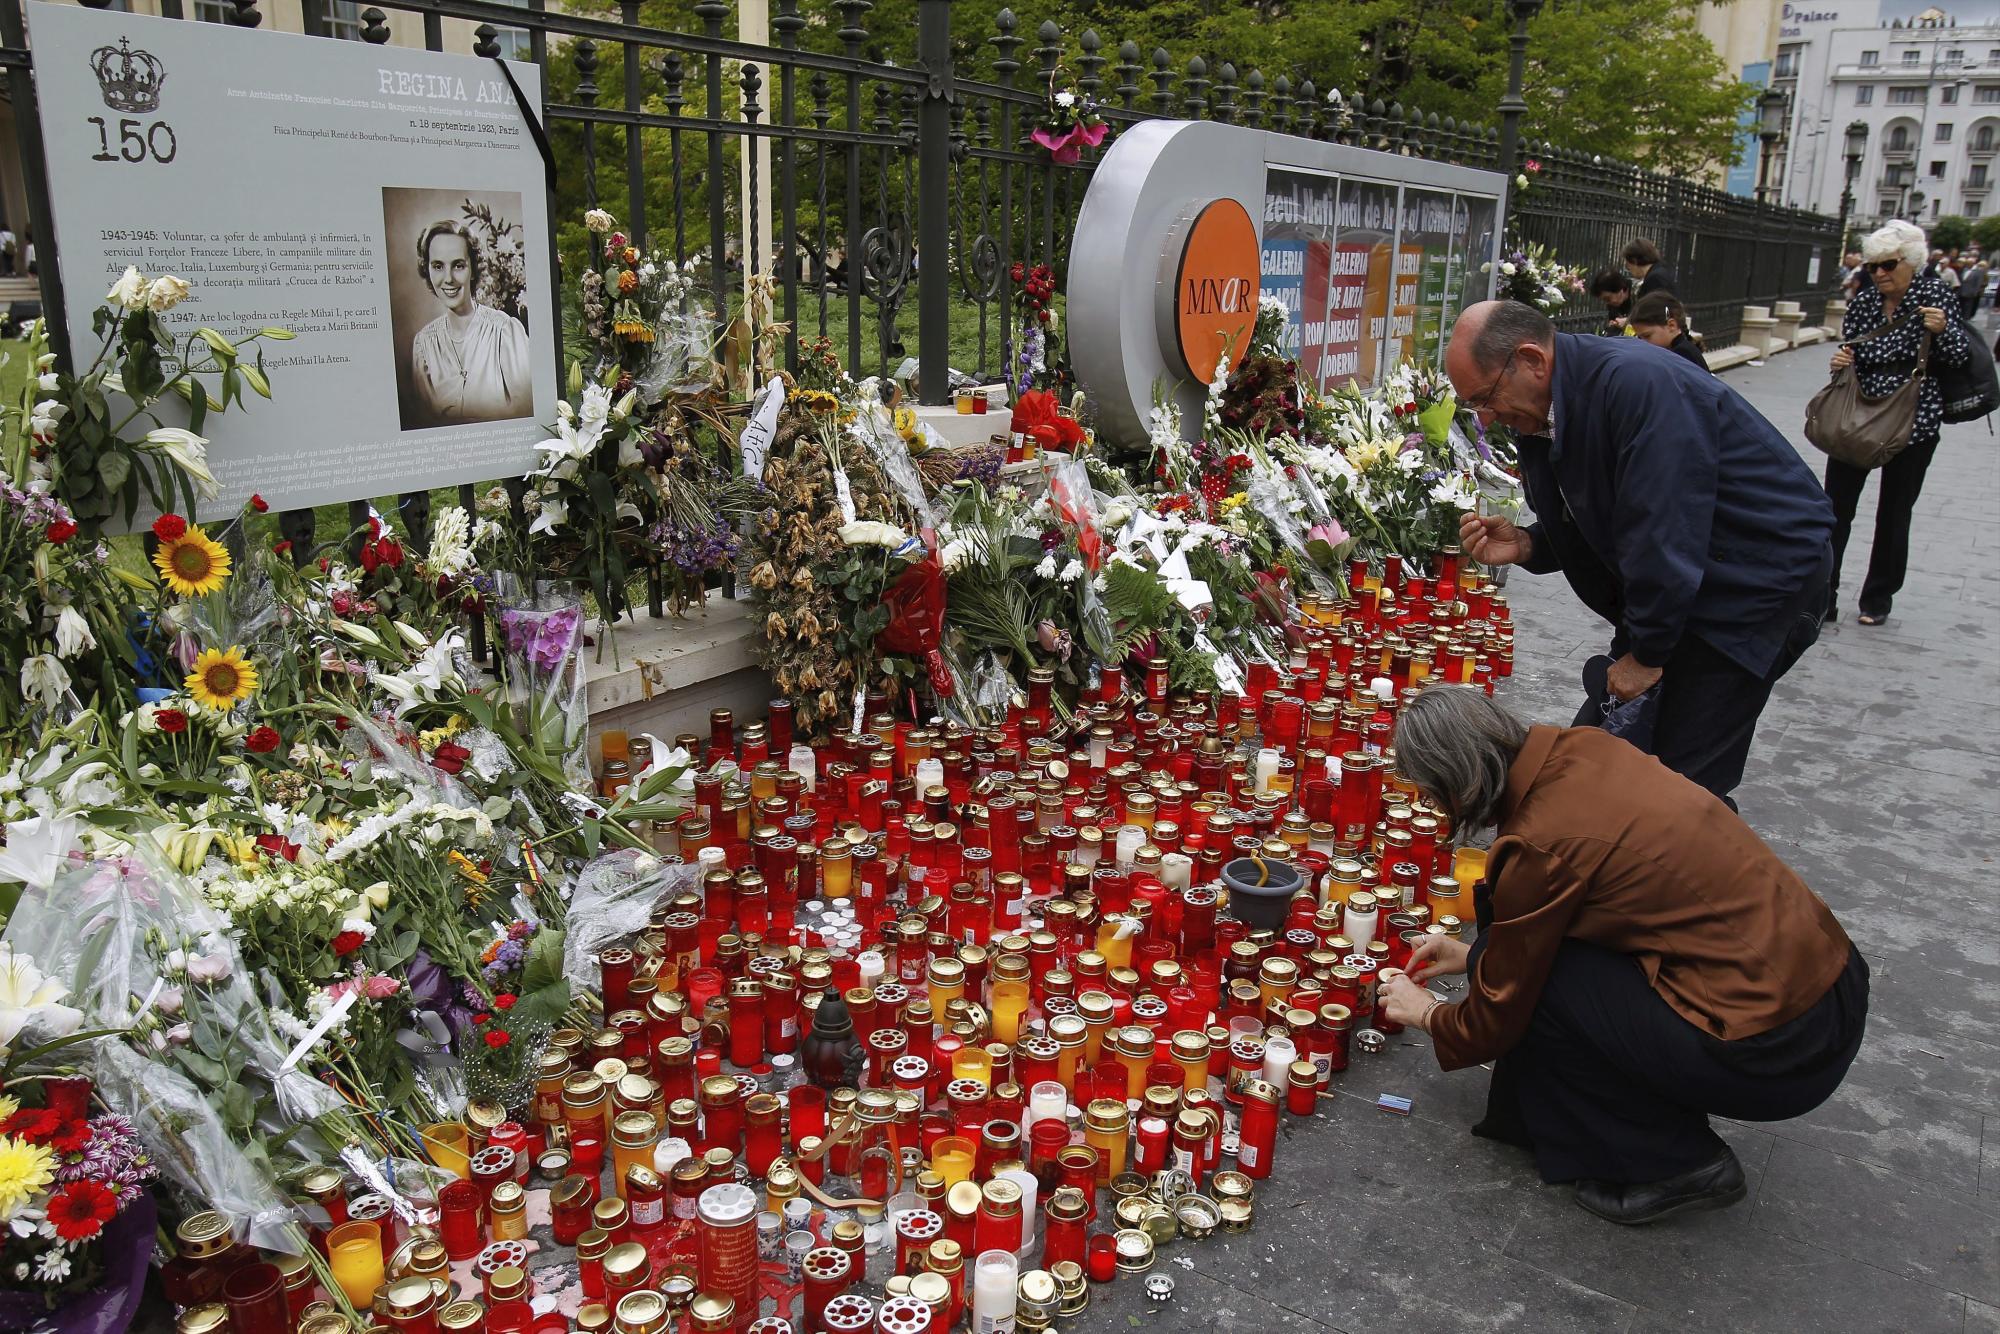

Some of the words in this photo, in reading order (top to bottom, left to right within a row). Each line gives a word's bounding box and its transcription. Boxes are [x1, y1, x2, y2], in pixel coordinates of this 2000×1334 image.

[1795, 10, 1838, 23] Palace
[227, 88, 247, 97] Anne
[249, 90, 293, 102] Antoinette
[378, 69, 467, 101] REGINA
[476, 80, 517, 106] ANA
[410, 119, 417, 128] n.
[420, 119, 429, 128] 18
[432, 120, 476, 132] septembrie
[478, 123, 497, 135] 1923,
[499, 126, 519, 135] Paris
[88, 117, 176, 163] 150
[274, 126, 290, 135] Fiica
[292, 127, 330, 139] Principelui
[331, 129, 348, 138] René
[350, 131, 358, 140] de
[359, 131, 409, 143] Bourbon-Parma
[421, 136, 453, 148] Principesei
[454, 139, 482, 149] Margareta
[1364, 191, 1380, 229] de
[1408, 197, 1420, 233] al
[101, 230, 158, 240] 1943-1945:
[163, 231, 205, 242] Voluntar,
[210, 233, 220, 241] ca
[249, 232, 259, 241] de
[363, 233, 371, 242] în
[103, 246, 143, 257] serviciul
[191, 247, 228, 257] Franceze
[233, 247, 263, 258] Libere,
[267, 248, 275, 257] în
[280, 247, 322, 259] campaniile
[327, 247, 356, 257] militare
[360, 247, 372, 257] din
[106, 262, 143, 275] Algea,
[146, 262, 178, 273] Maroc,
[181, 262, 206, 273] Italia,
[209, 262, 259, 274] Luxemburg
[270, 262, 312, 272] Germania;
[314, 263, 340, 273] pentru
[342, 261, 373, 270] serviciile
[1261, 250, 1304, 276] GALERIA
[1333, 252, 1369, 275] GALERIA
[322, 275, 331, 285] de
[1186, 277, 1251, 315] MNaR
[1330, 286, 1342, 309] DE
[1342, 281, 1364, 309] ARTĂ
[171, 312, 197, 323] 1947:
[200, 313, 215, 322] Are
[217, 312, 231, 321] loc
[233, 311, 267, 323] logodna
[282, 310, 308, 321] Regele
[311, 308, 333, 318] Mihai
[344, 310, 353, 319] pe
[355, 308, 370, 316] care
[286, 323, 320, 333] Elisabeta
[328, 322, 349, 331] Marii
[351, 320, 378, 330] Britanii
[262, 359, 288, 370] Regele
[290, 357, 312, 366] Mihai
[317, 356, 324, 364] la
[327, 355, 351, 363] Atena.
